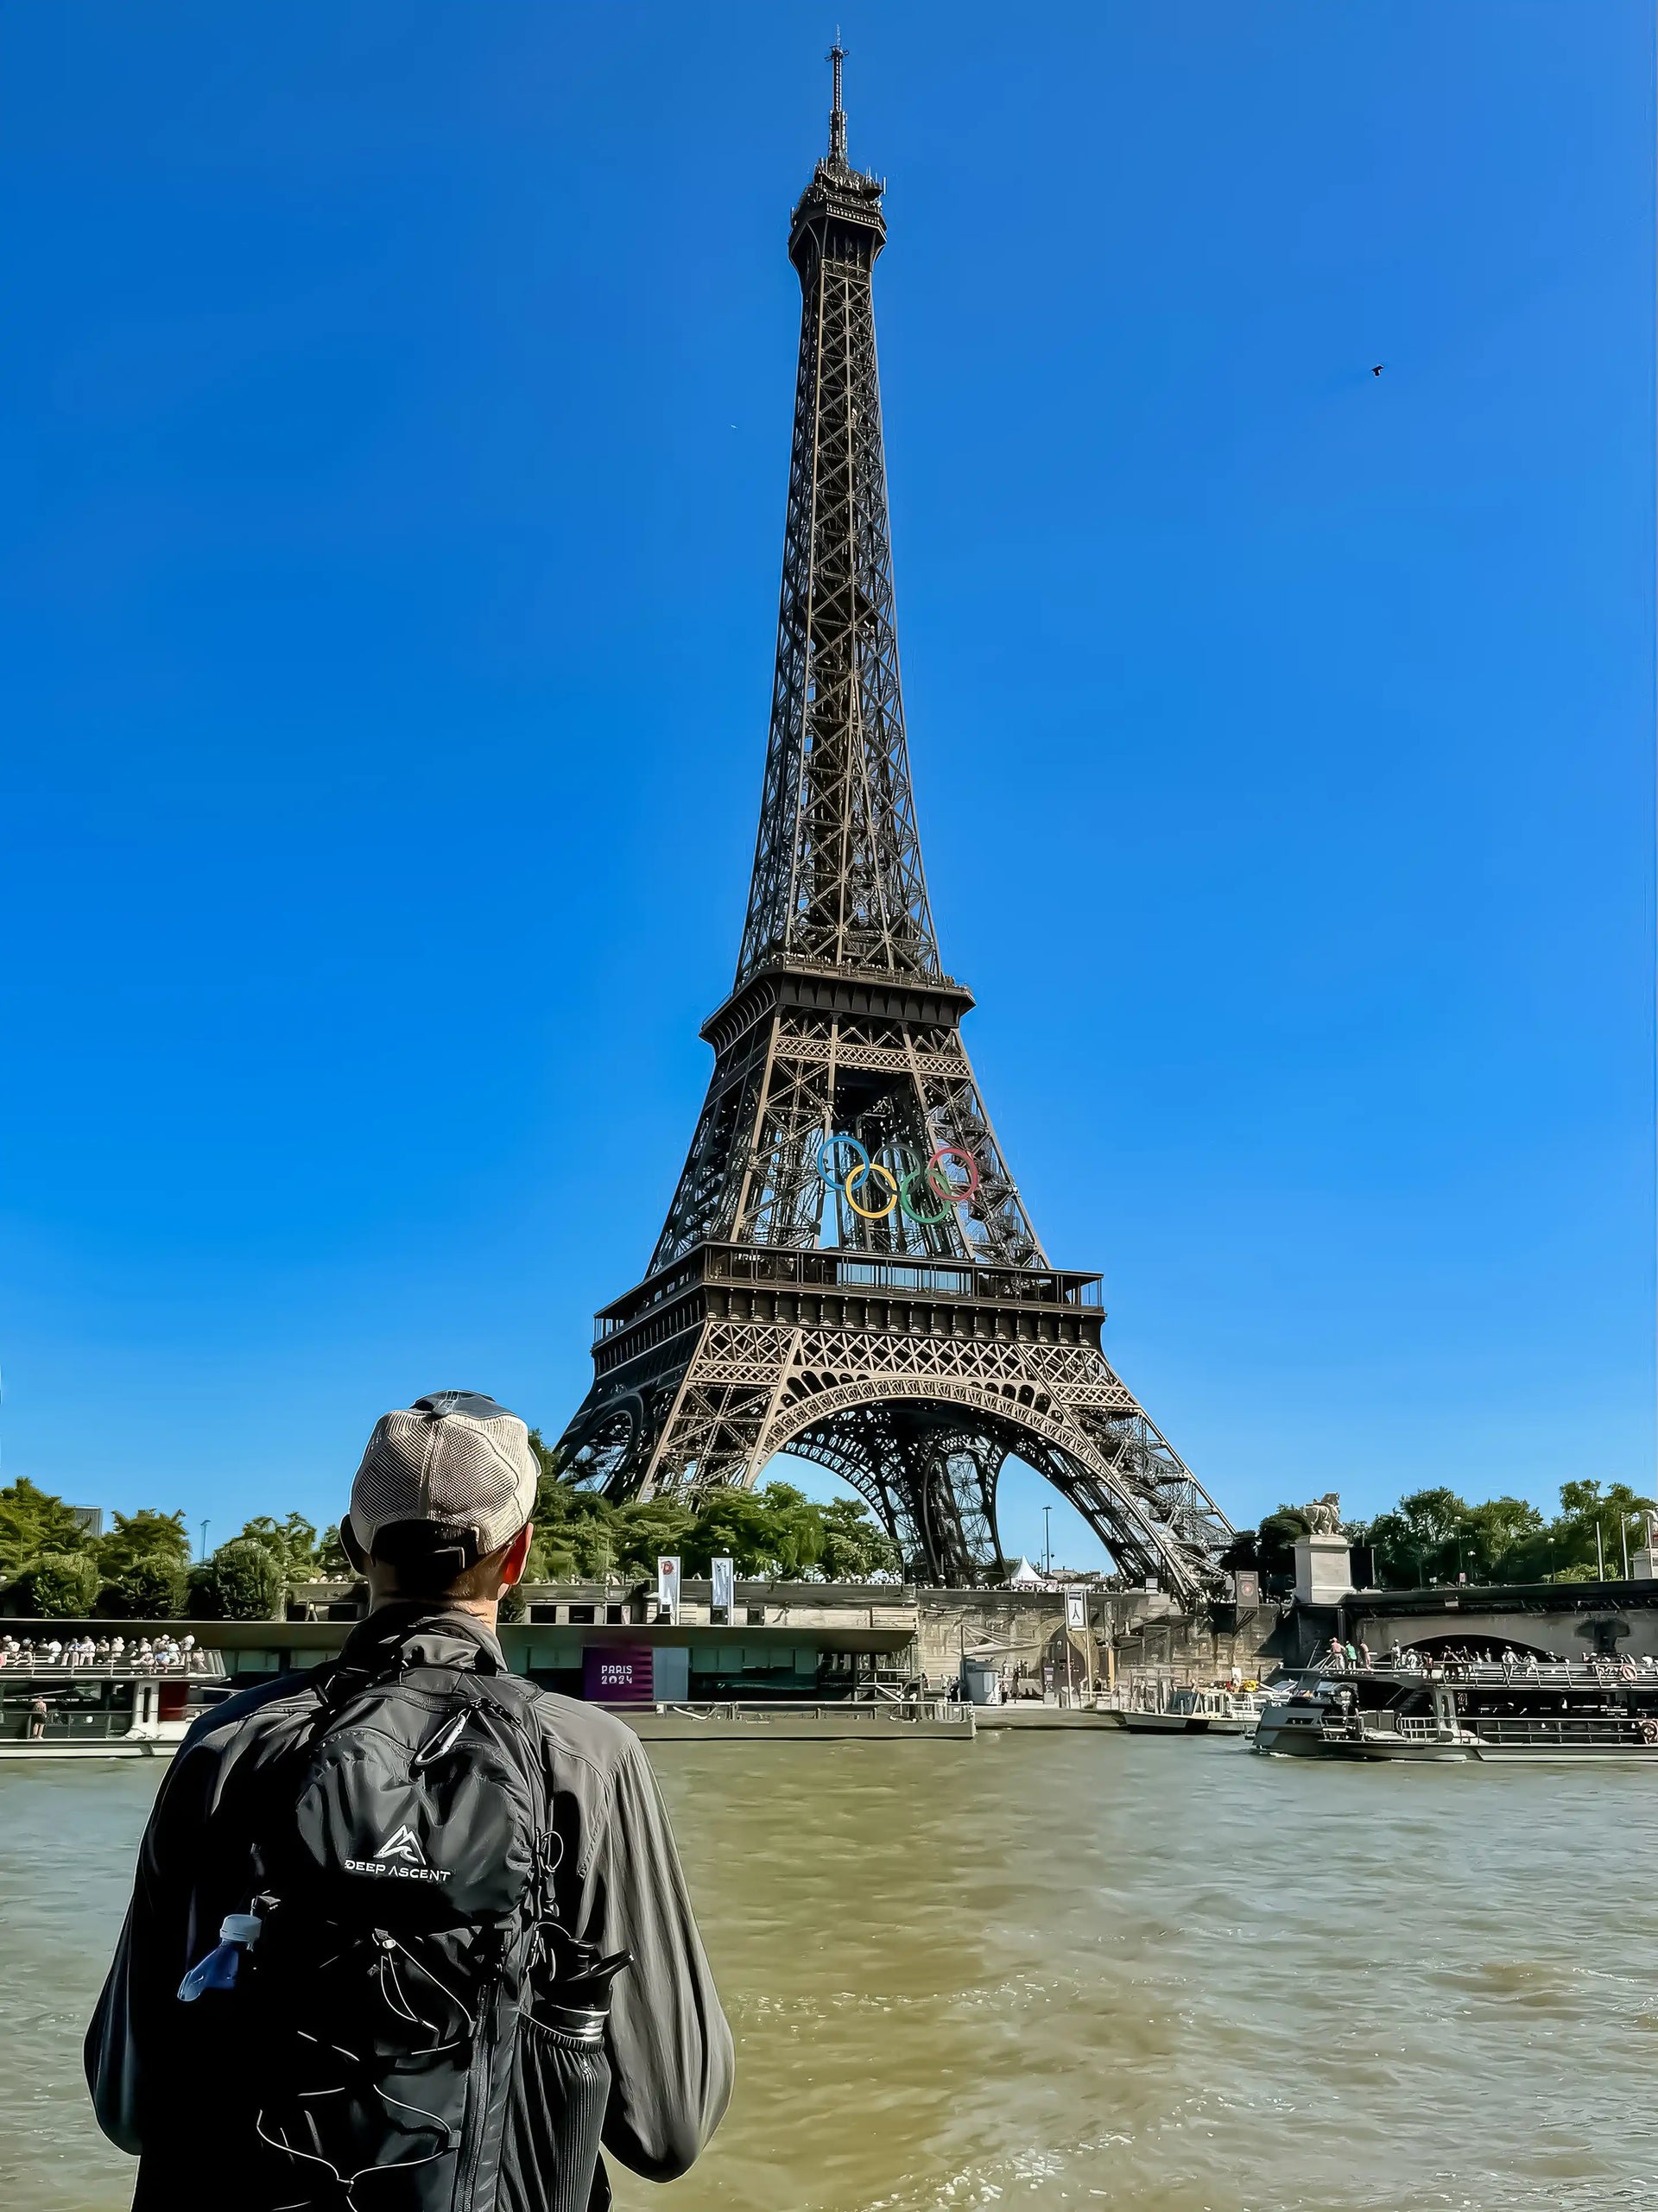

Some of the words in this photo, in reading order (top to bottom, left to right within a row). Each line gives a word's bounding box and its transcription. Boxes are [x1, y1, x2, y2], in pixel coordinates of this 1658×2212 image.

[601, 1665, 632, 1674] PARIS
[601, 1675, 632, 1684] 2024
[344, 1859, 386, 1874] DEEP
[389, 1865, 451, 1881] ASCENT
